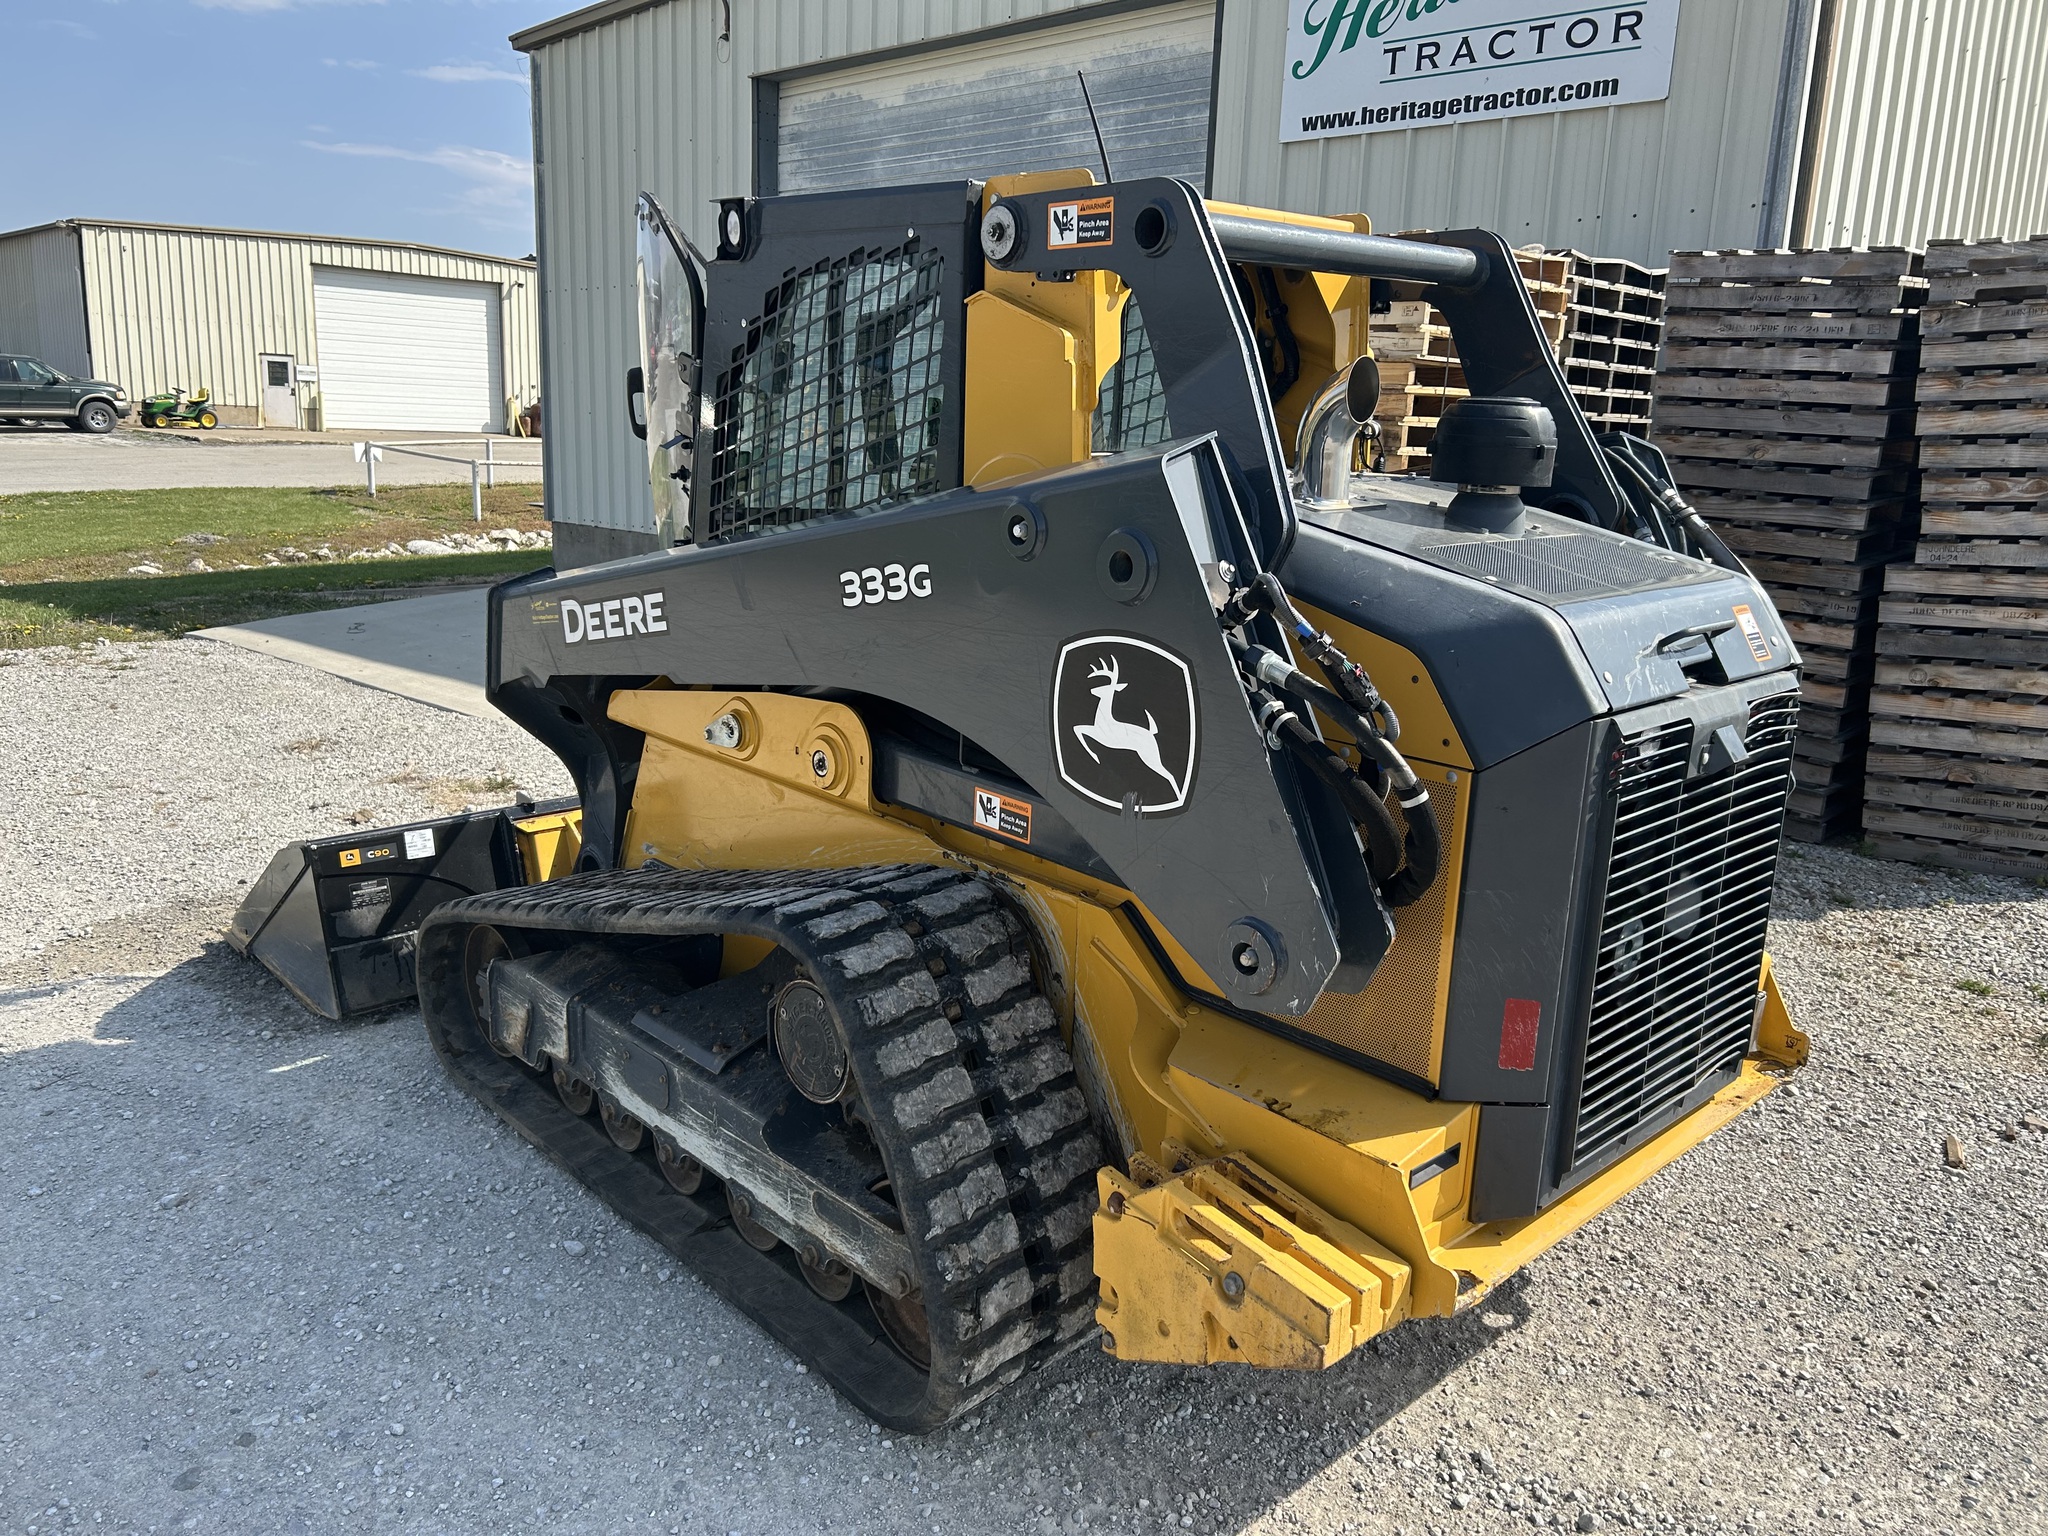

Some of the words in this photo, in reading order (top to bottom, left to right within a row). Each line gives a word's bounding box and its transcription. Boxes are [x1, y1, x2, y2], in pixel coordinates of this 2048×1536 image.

[1382, 10, 1644, 76] TRACTOR
[1301, 77, 1619, 133] www.heritagetractor.com
[1085, 200, 1112, 210] WARNING
[1080, 220, 1095, 229] Pinch
[1096, 219, 1109, 227] Area
[1929, 553, 1958, 562] 04-24
[839, 563, 933, 607] 333G
[560, 592, 668, 644] DEERE
[1972, 797, 2001, 808] DEERE
[1001, 812, 1015, 823] Pinch
[1015, 818, 1027, 828] Area
[1000, 821, 1011, 831] Keep
[367, 848, 390, 858] C90
